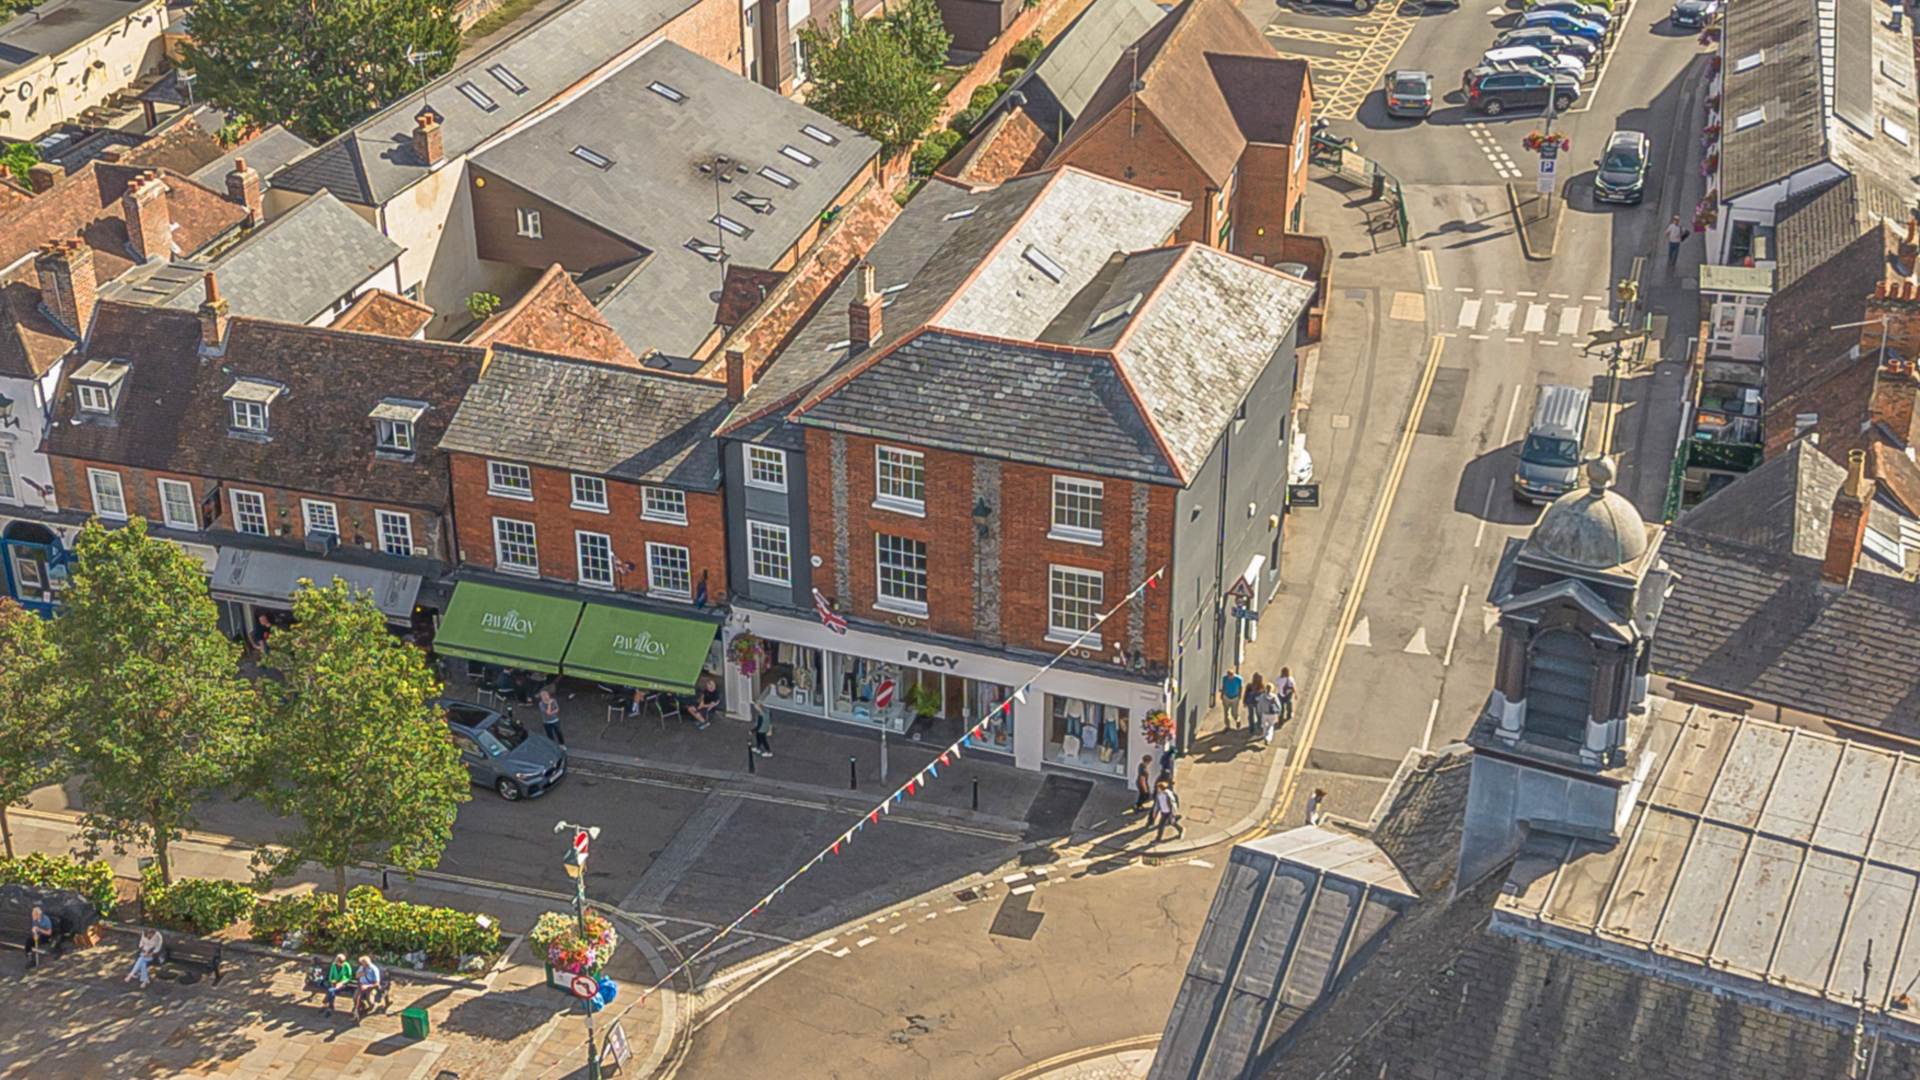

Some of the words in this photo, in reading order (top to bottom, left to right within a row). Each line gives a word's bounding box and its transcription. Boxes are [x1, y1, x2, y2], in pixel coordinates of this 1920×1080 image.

[1544, 161, 1552, 173] P
[481, 612, 536, 634] PAVILION
[612, 634, 668, 656] PAVILION
[907, 650, 959, 669] FACY
